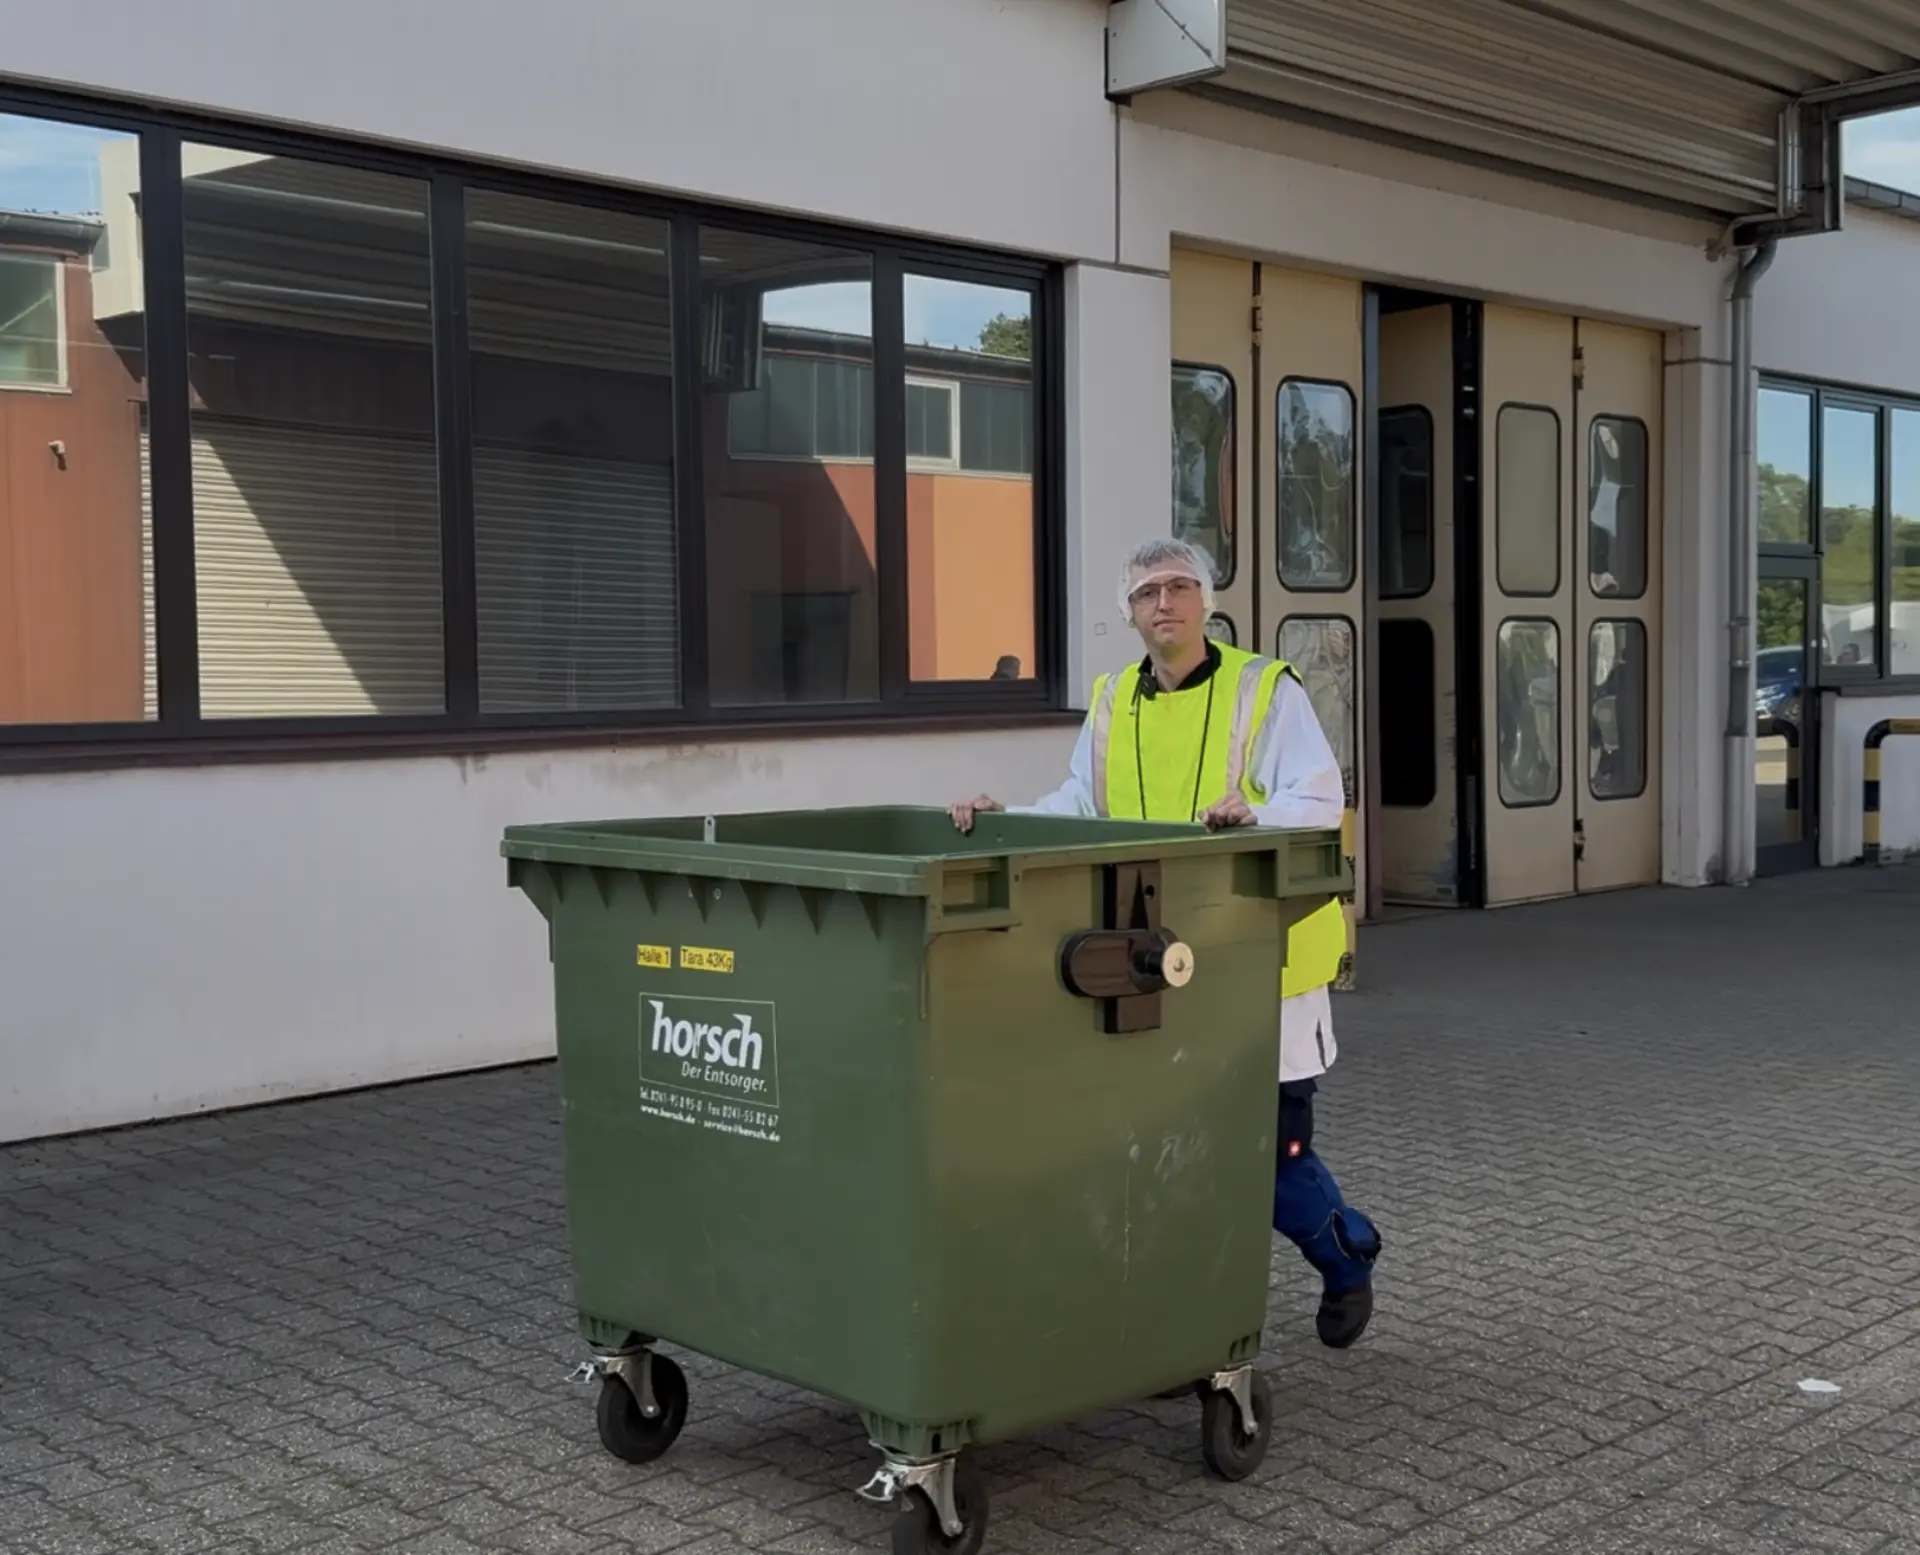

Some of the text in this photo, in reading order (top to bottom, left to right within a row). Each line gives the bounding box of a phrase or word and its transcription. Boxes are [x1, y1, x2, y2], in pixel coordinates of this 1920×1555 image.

[682, 948, 732, 970] Tara 43Kg
[648, 999, 763, 1070] horsch
[681, 1061, 768, 1094] Der Entsorger.
[640, 1104, 696, 1125] www.horsch.de
